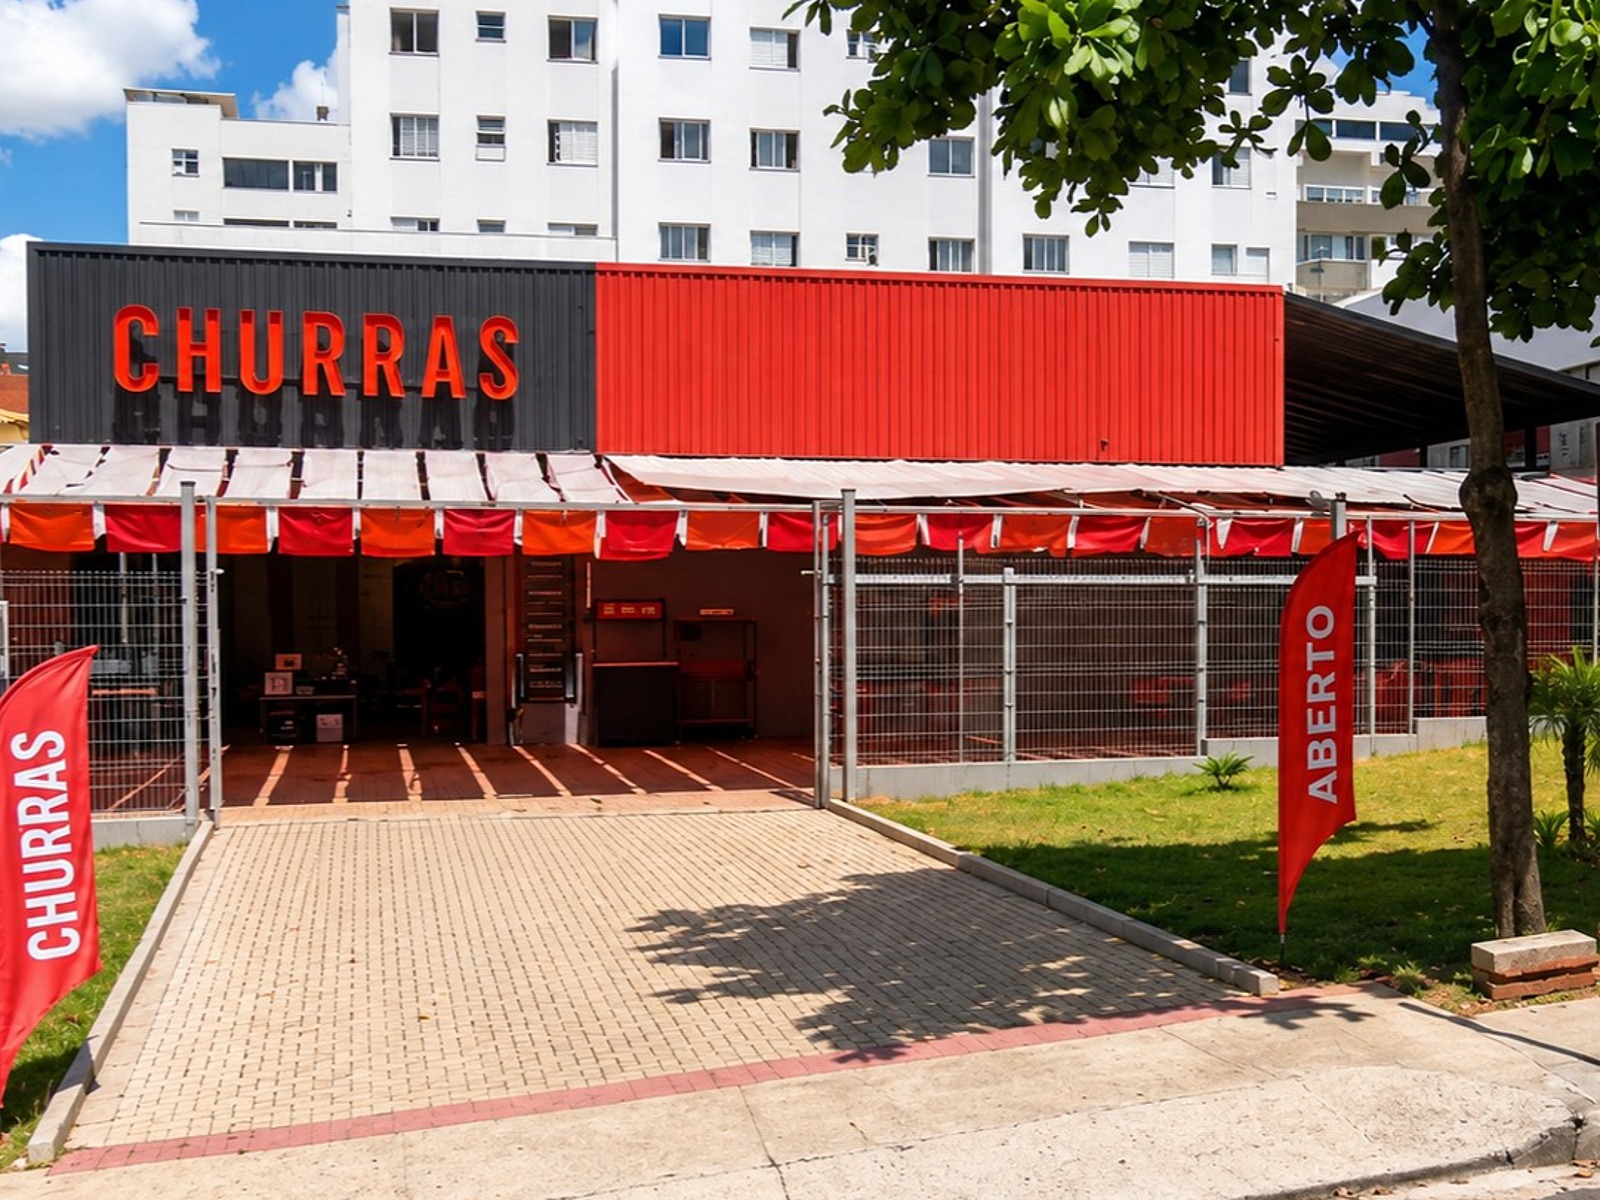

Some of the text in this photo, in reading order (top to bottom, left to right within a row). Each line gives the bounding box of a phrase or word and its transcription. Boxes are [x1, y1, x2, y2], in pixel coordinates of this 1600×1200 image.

[113, 304, 519, 400] CHURRAS
[1305, 604, 1338, 804] ABERTO
[10, 730, 81, 961] CHURRAS
